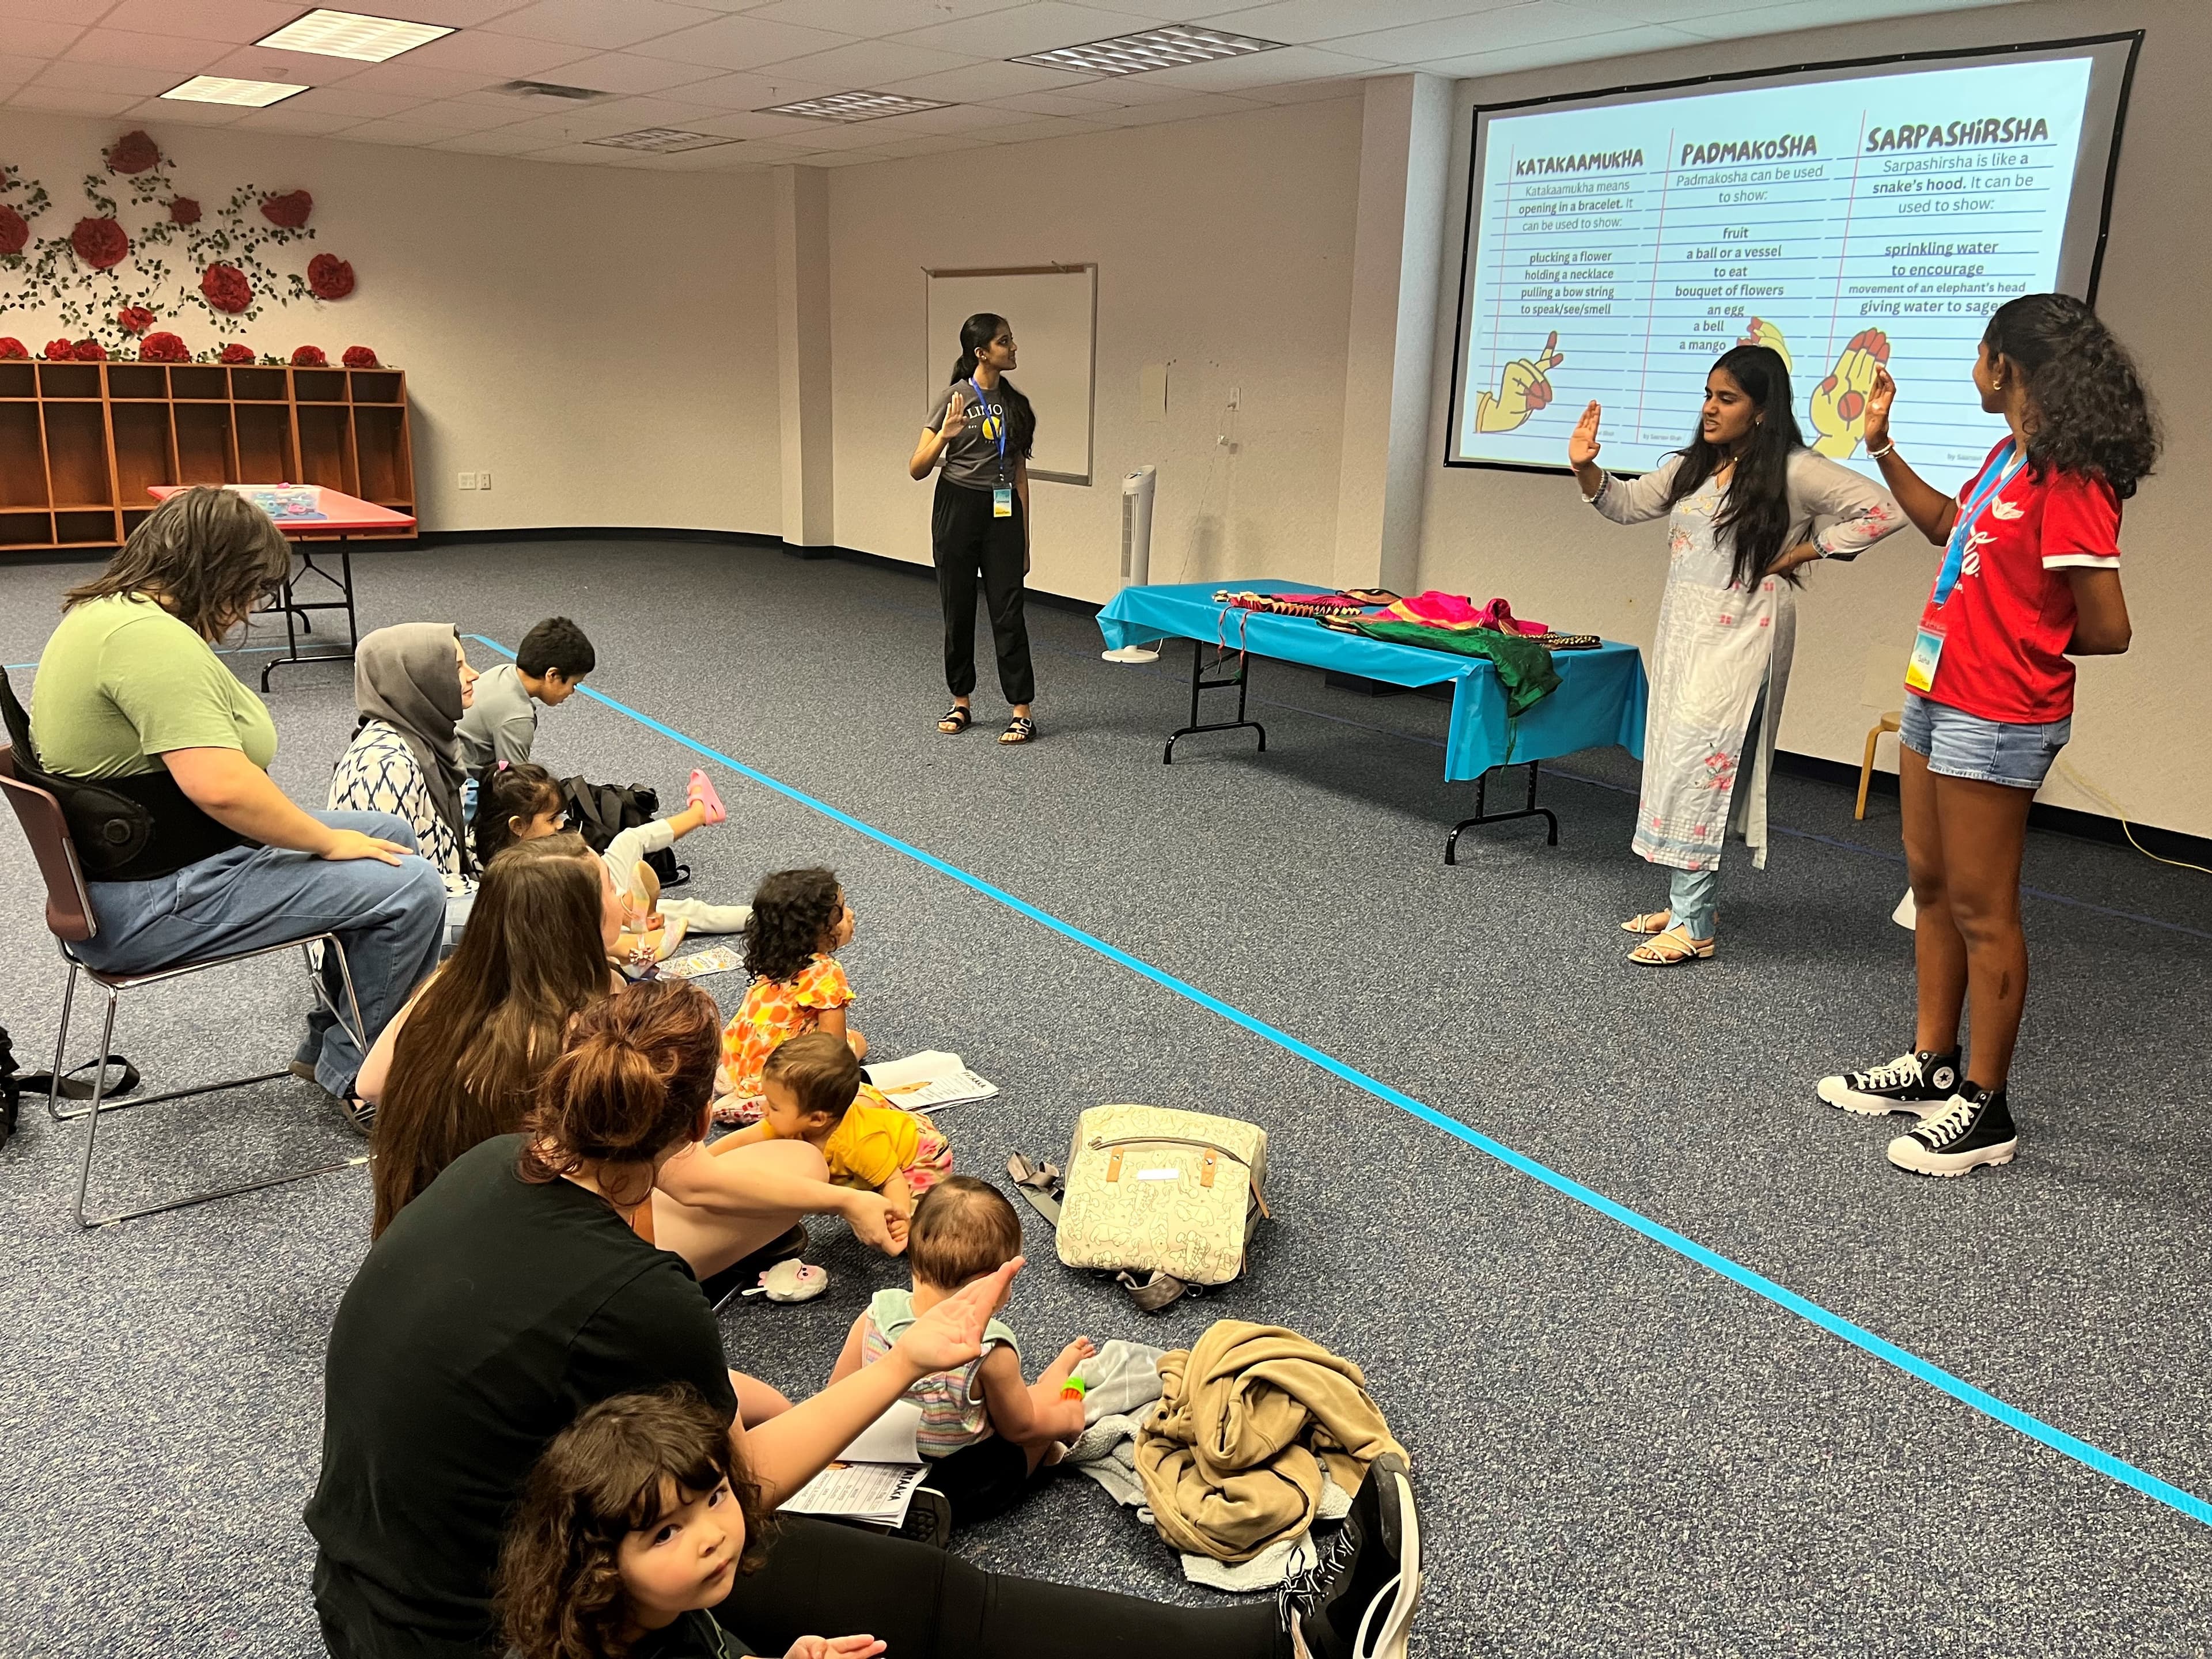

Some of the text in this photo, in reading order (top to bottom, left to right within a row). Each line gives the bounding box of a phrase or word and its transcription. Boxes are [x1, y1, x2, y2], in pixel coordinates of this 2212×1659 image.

[1681, 135, 1817, 166] PADMAKOSHA
[1516, 149, 1643, 176] KATAKAAMUKHA
[1884, 153, 2028, 173] Sarpashirsha is like a
[1676, 165, 1823, 187] Padmakosha can be used
[1926, 177, 1967, 191] hood.
[1971, 177, 1981, 189] It
[1985, 177, 2011, 188] can
[2016, 175, 2033, 187] be
[1525, 181, 1630, 197] Katakaamukha means
[1719, 190, 1768, 203] to show:
[1519, 203, 1556, 215] opening
[1559, 201, 1567, 211] in
[1578, 199, 1623, 210] bracelet.
[1626, 199, 1633, 208] It
[1899, 198, 1994, 213] used to show:
[1522, 217, 1622, 231] can be used to show:
[1723, 228, 1748, 239] fruit
[1687, 245, 1782, 259] a ball or a vessel
[1885, 241, 1999, 257] sprinkling water
[1530, 253, 1569, 265] plucking
[1580, 252, 1612, 262] flower
[1525, 269, 1559, 282] holding
[1570, 269, 1613, 279] necklace
[1714, 267, 1748, 277] to eat
[1892, 264, 1984, 278] to encourage
[1521, 287, 1552, 299] pulling
[1563, 287, 1582, 296] bow
[1585, 286, 1614, 299] string
[1675, 285, 1783, 299] bouquet of flowers
[1849, 284, 1904, 294] movement
[1907, 283, 1918, 293] of
[1921, 285, 1934, 293] an
[1997, 281, 2026, 293] head
[1521, 304, 1611, 317] to speak/see/smell
[1707, 306, 1744, 317] an egg
[1861, 300, 1900, 316] giving
[1904, 301, 1944, 312] water
[1948, 301, 1961, 312] to
[1703, 320, 1724, 331] bell
[1680, 340, 1726, 353] a mango
